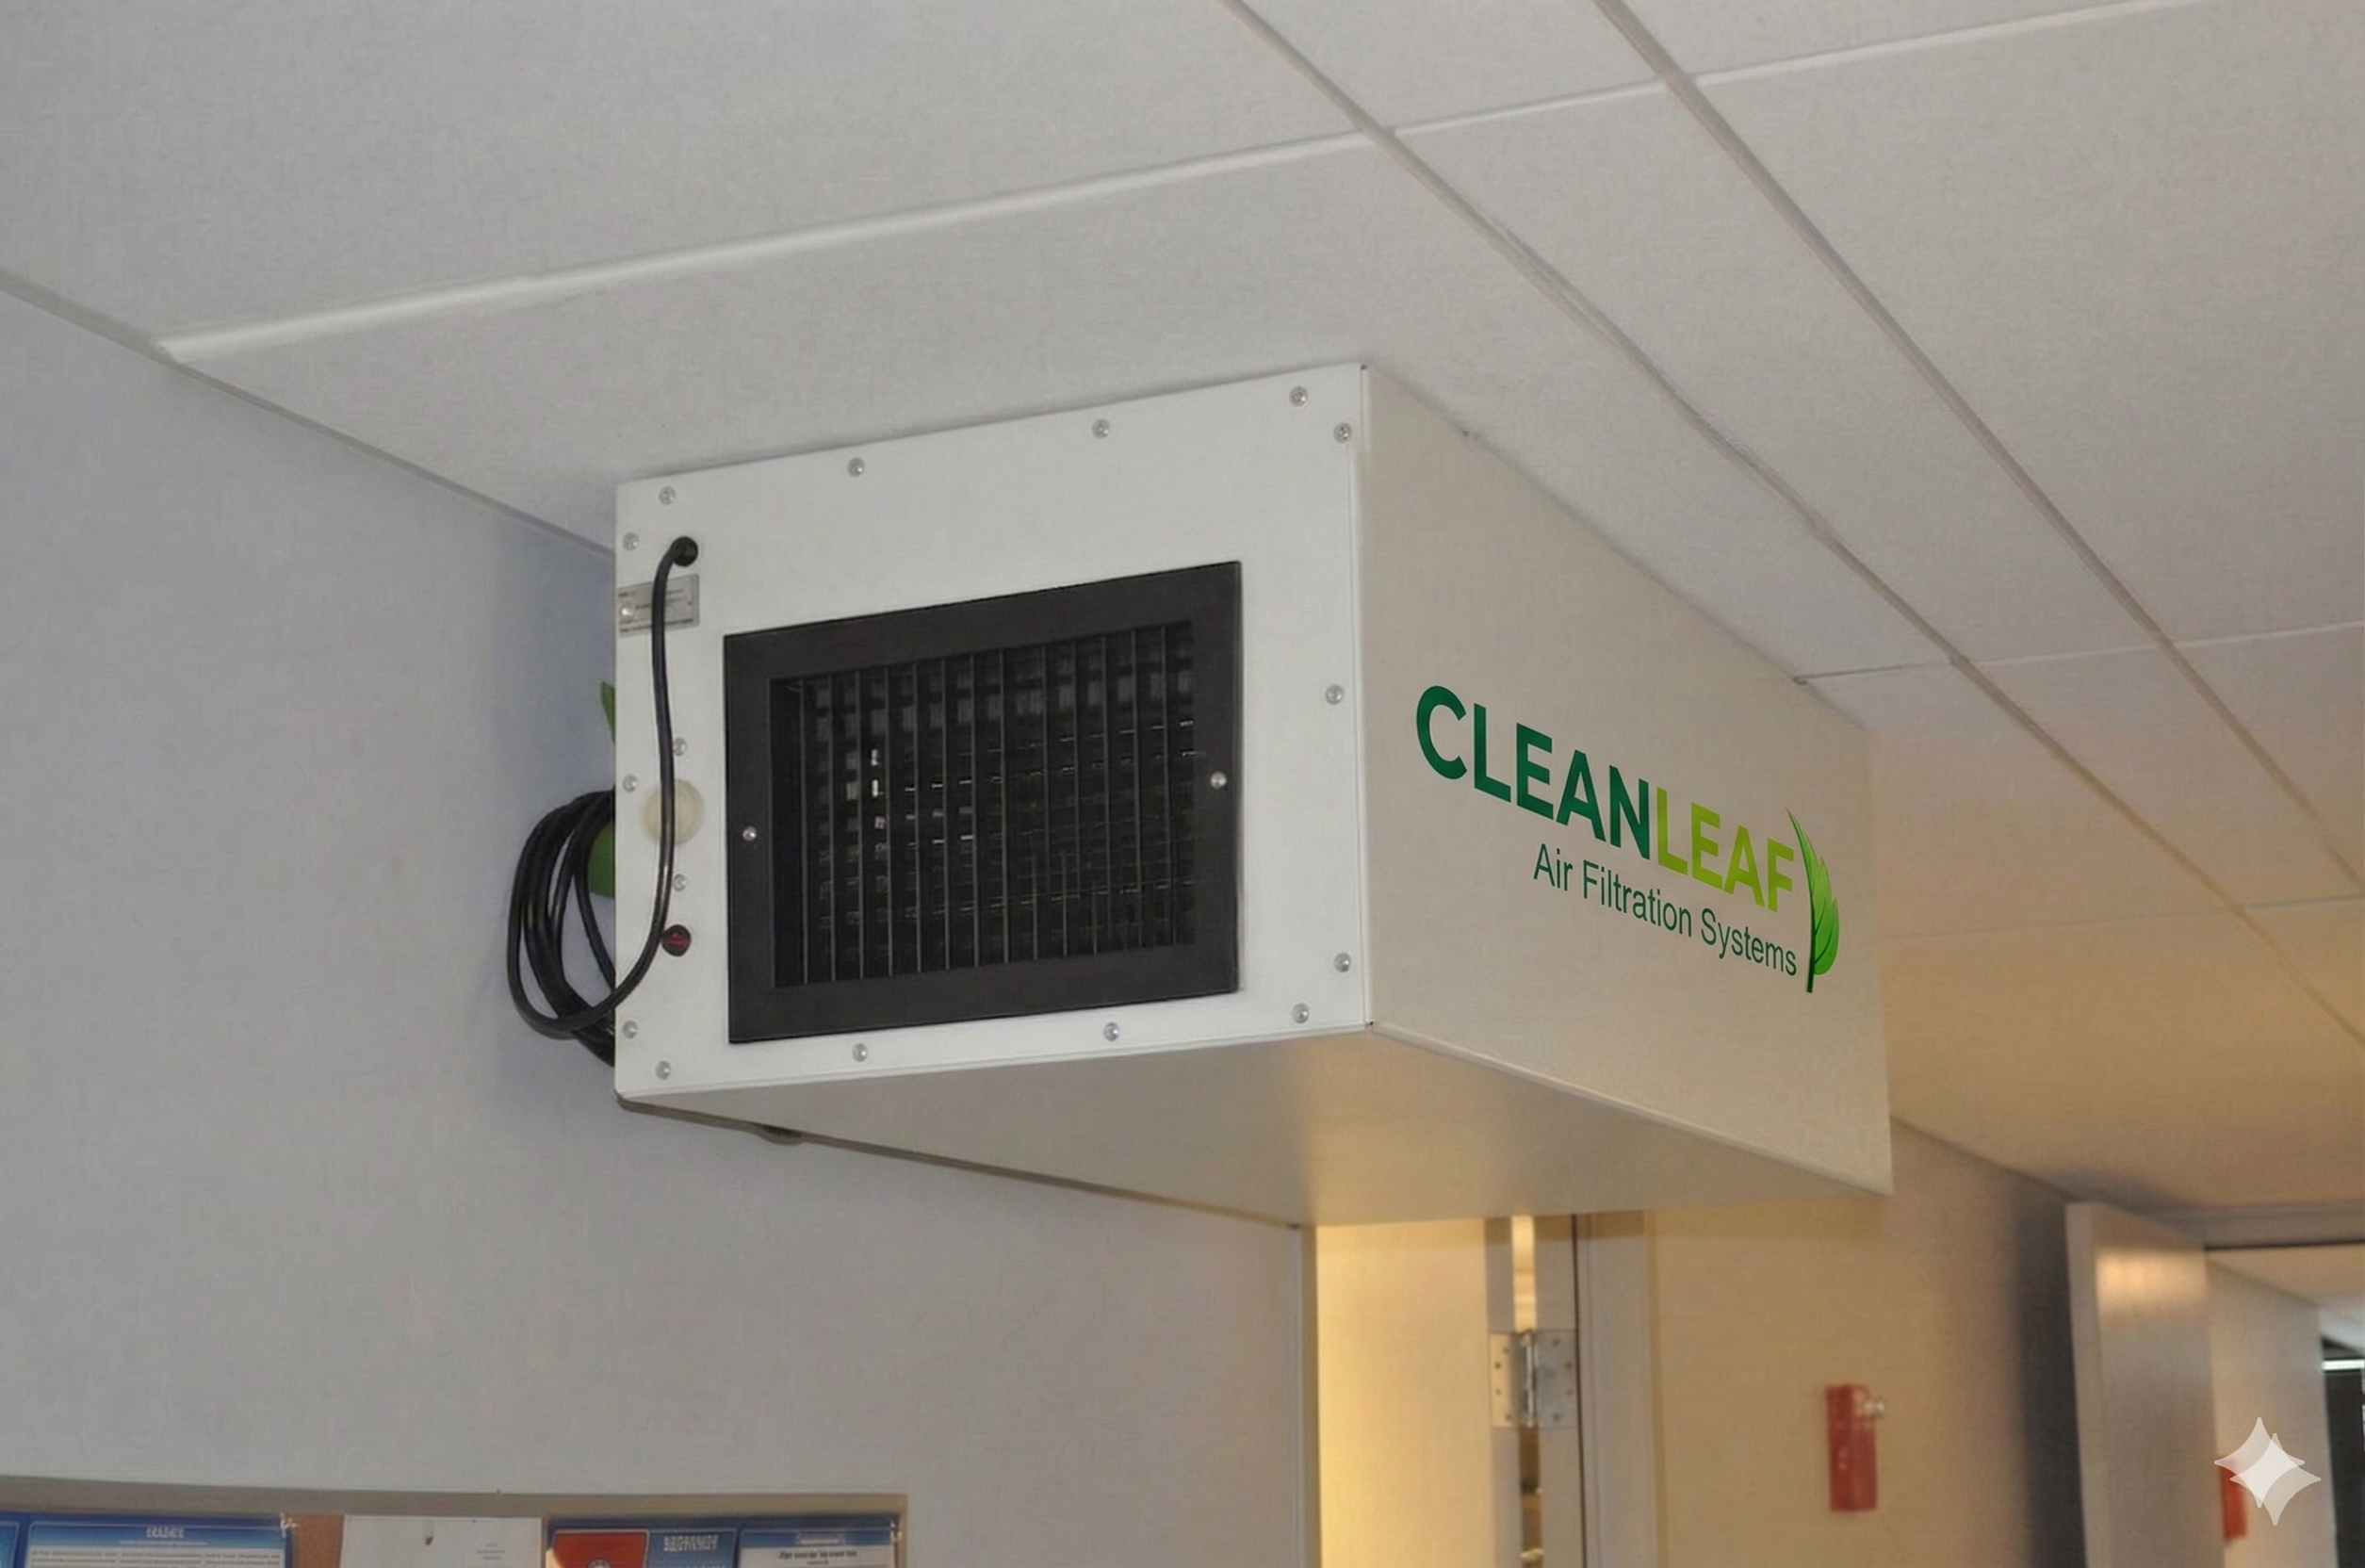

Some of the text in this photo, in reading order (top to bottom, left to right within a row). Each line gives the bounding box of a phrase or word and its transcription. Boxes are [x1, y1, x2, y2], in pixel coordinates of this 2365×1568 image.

[1416, 685, 1795, 912] CLEANLEAF
[1533, 843, 1797, 976] Air Filtration Systems
